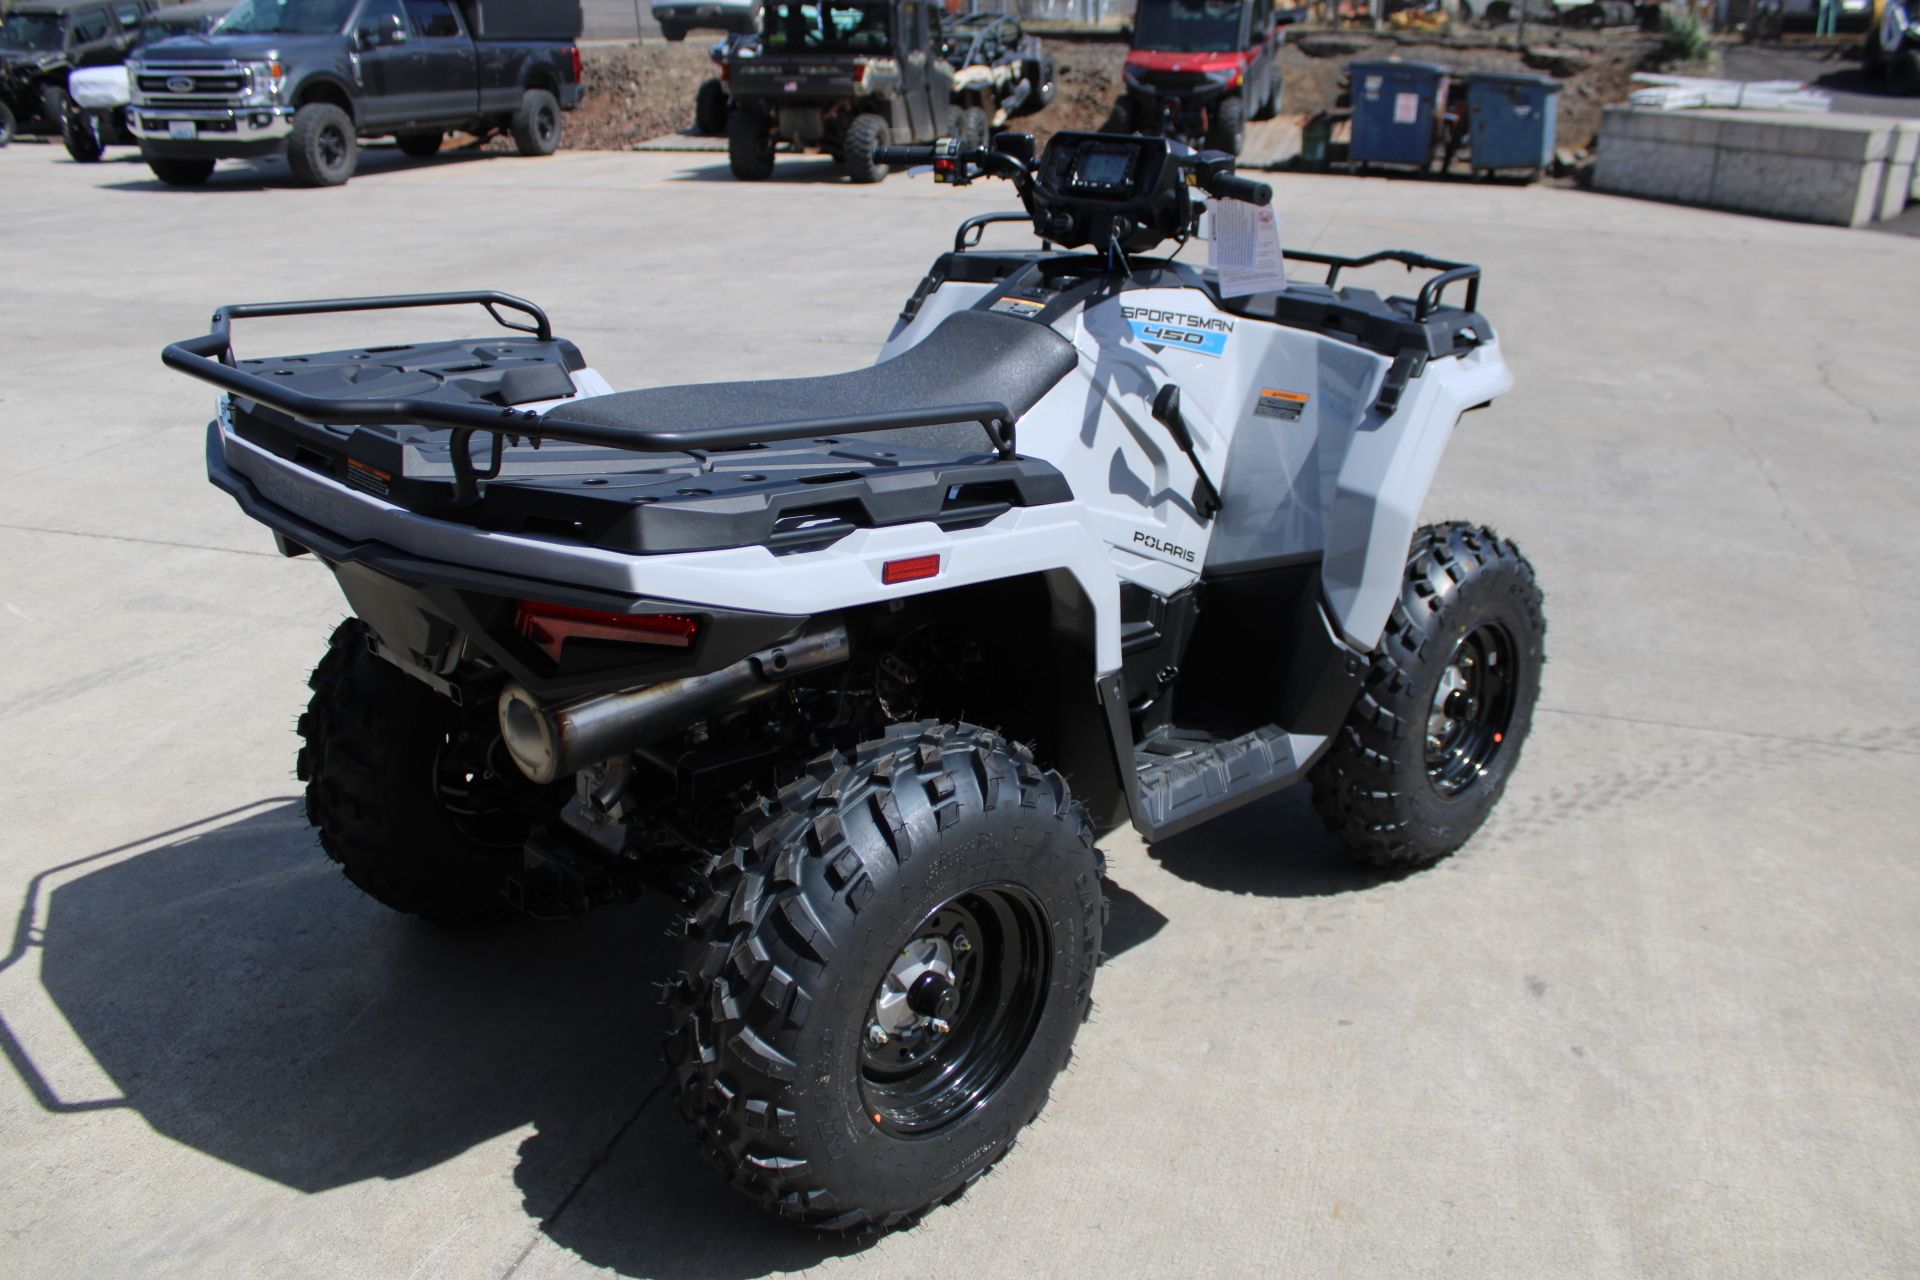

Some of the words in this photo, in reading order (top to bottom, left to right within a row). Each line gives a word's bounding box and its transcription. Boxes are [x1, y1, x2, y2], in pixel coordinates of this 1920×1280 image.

[1121, 306, 1234, 333] SPORTSMAN
[1144, 326, 1204, 345] 450
[1133, 531, 1196, 562] POLARIS
